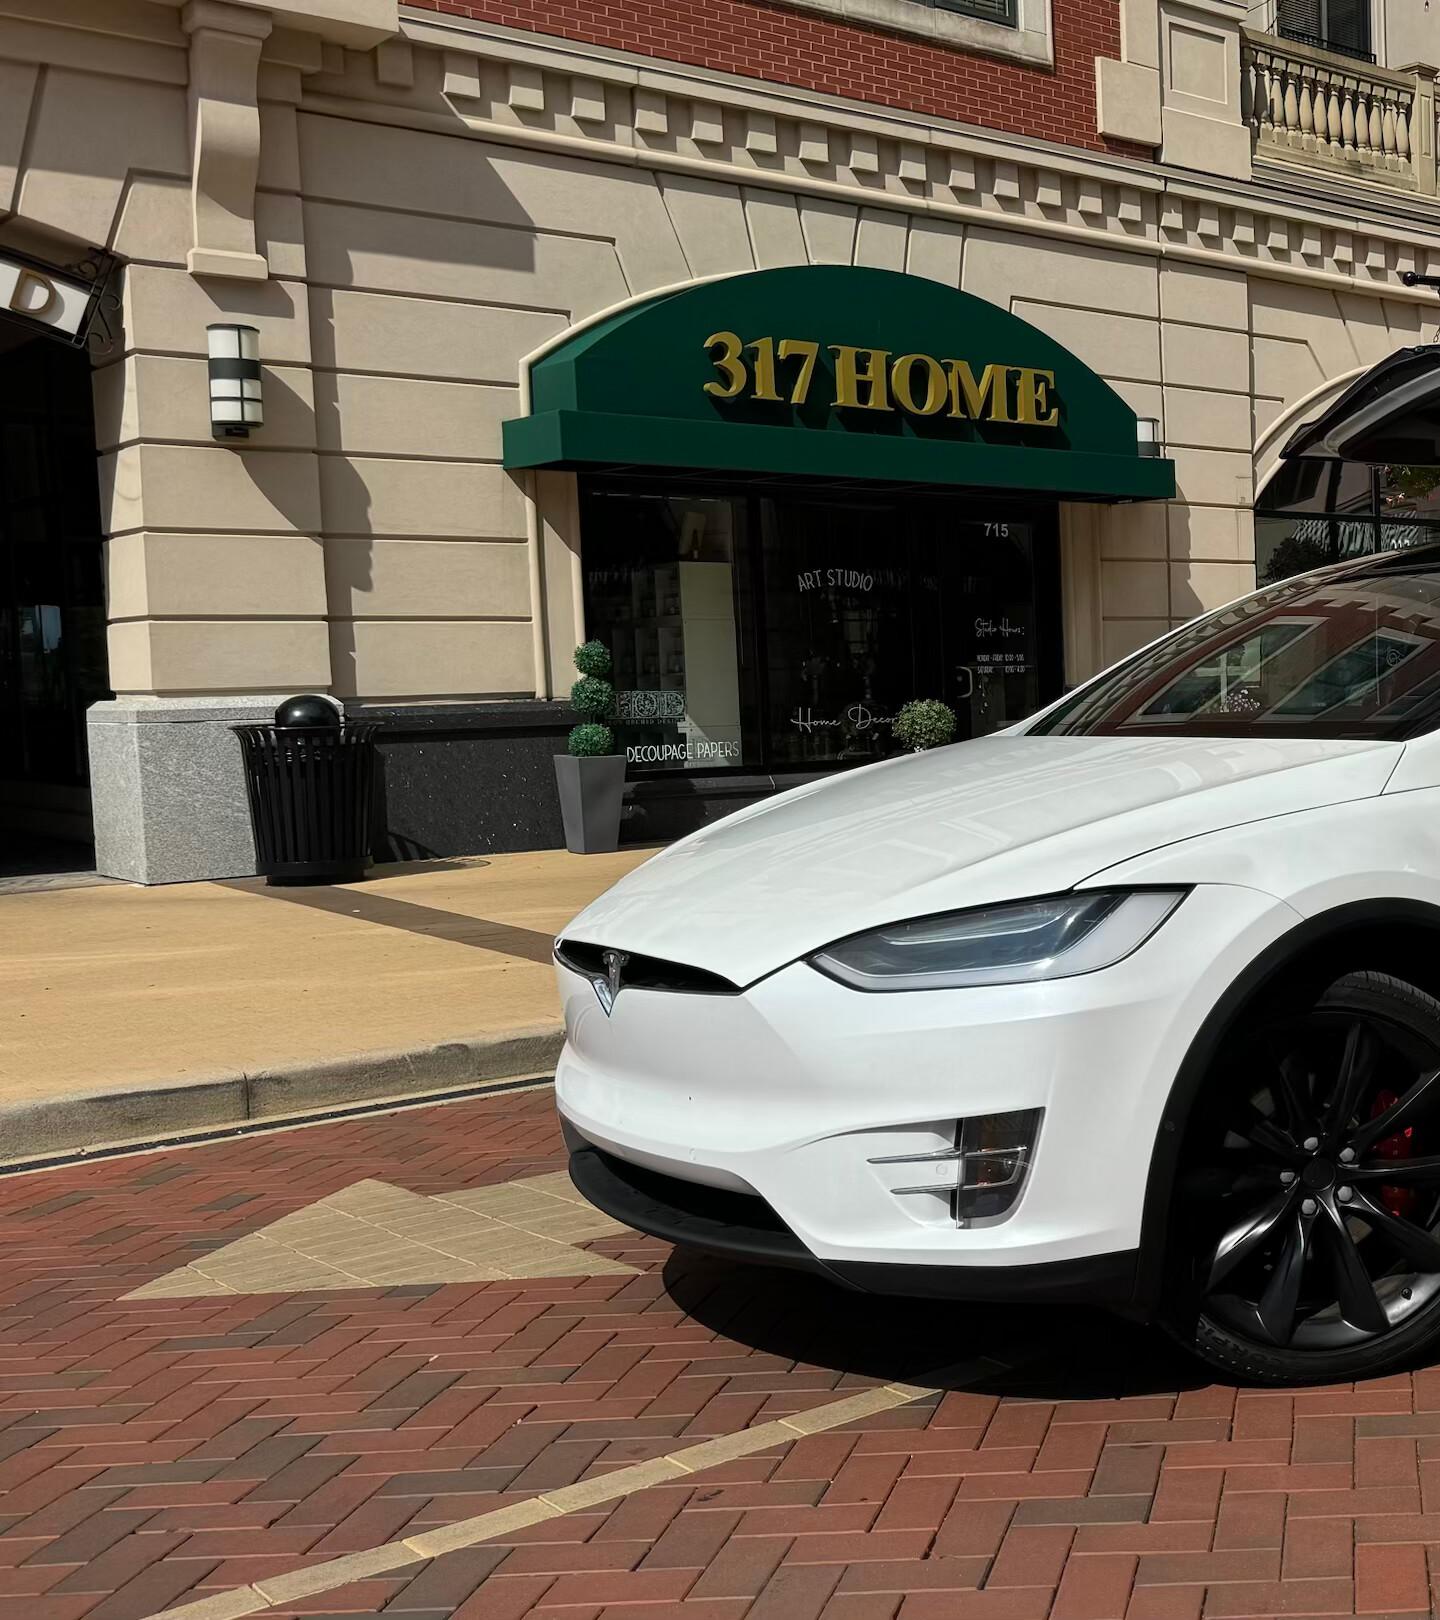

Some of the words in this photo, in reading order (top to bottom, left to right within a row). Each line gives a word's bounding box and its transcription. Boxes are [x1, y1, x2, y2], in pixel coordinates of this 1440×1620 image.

[703, 331, 819, 404] 317
[827, 344, 1059, 427] HOME
[984, 522, 1009, 538] 715
[798, 569, 822, 592] ART
[827, 568, 874, 592] STUDIO
[790, 706, 842, 733] Home
[626, 743, 694, 763] DECOUPAGE
[697, 740, 740, 759] PAPERS
